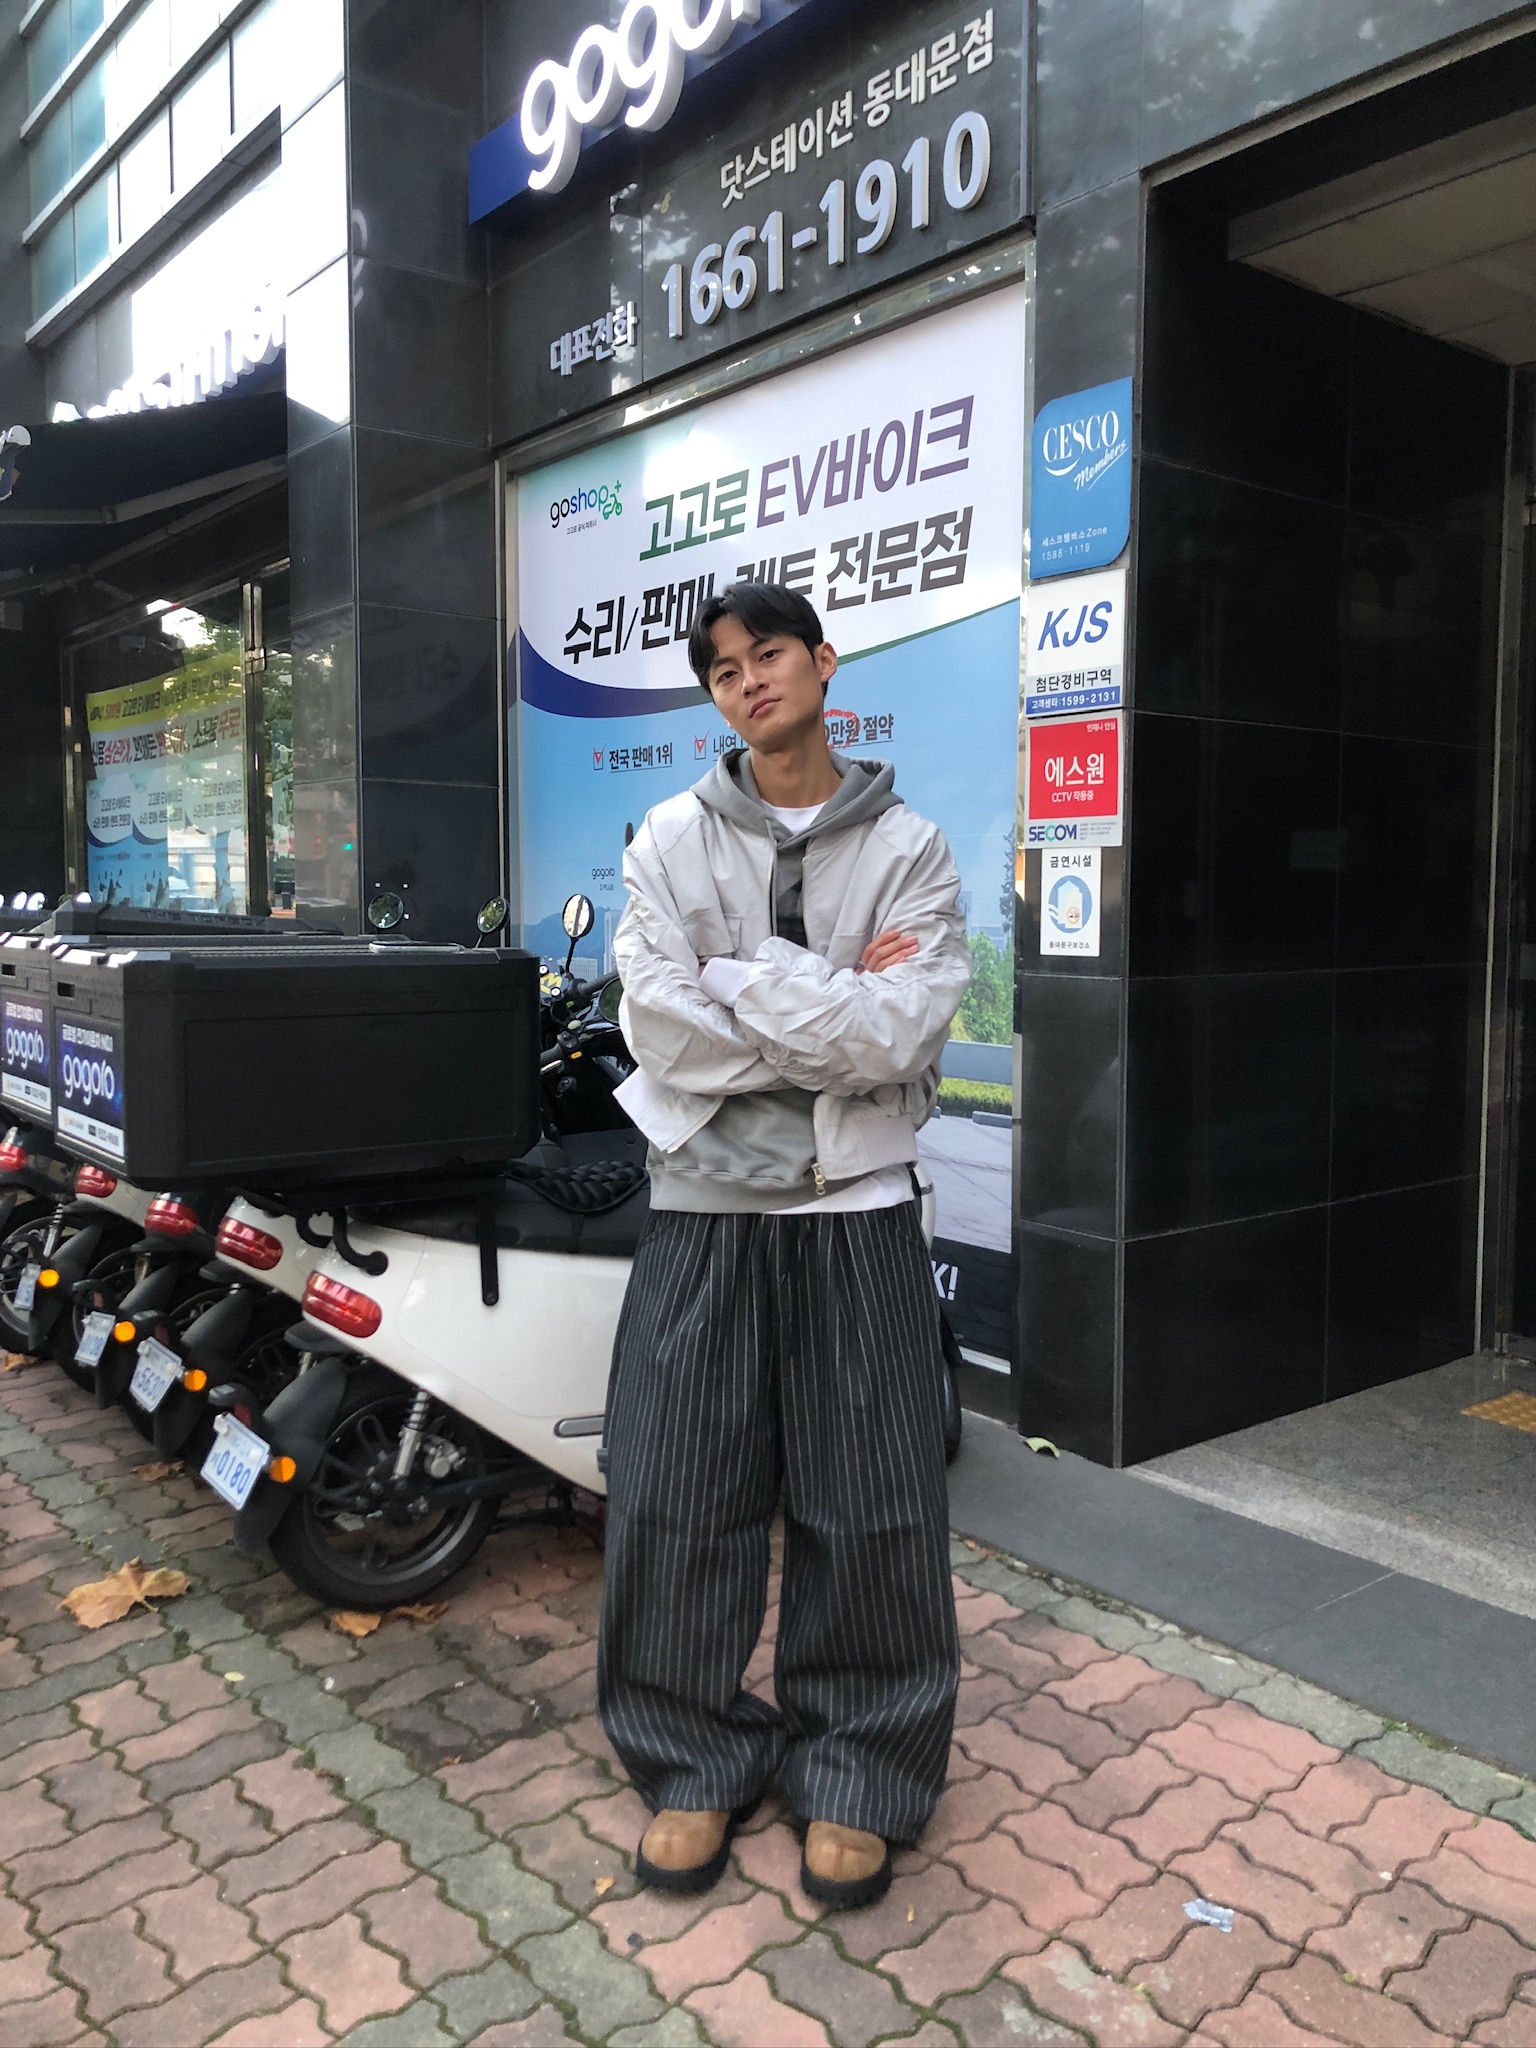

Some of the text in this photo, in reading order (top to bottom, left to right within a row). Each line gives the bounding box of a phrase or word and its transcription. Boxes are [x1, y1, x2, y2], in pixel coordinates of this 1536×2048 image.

[719, 8, 995, 209] 닷스테이션 동대문점
[550, 111, 992, 376] 대표전화 1661-1910
[1043, 410, 1119, 463] CESCO
[639, 395, 975, 561] 고고로 EV바이크
[1073, 439, 1127, 491] Members
[826, 505, 975, 612] 전문점
[1041, 543, 1090, 560] 1588-1119
[1037, 600, 1113, 651] KJS
[1036, 669, 1112, 693] 첨단경비구역
[863, 713, 894, 741] 절약
[1086, 721, 1116, 732] 언제나 안심
[609, 742, 673, 770] 전국 판매 1위
[1044, 753, 1104, 787] 에스원
[1051, 790, 1094, 803] CCTV 작동중
[1028, 824, 1077, 842] SECOM
[1050, 854, 1092, 868] 금연시설
[1049, 941, 1090, 949] 동대문구보건소
[216, 1449, 252, 1495] 0180
